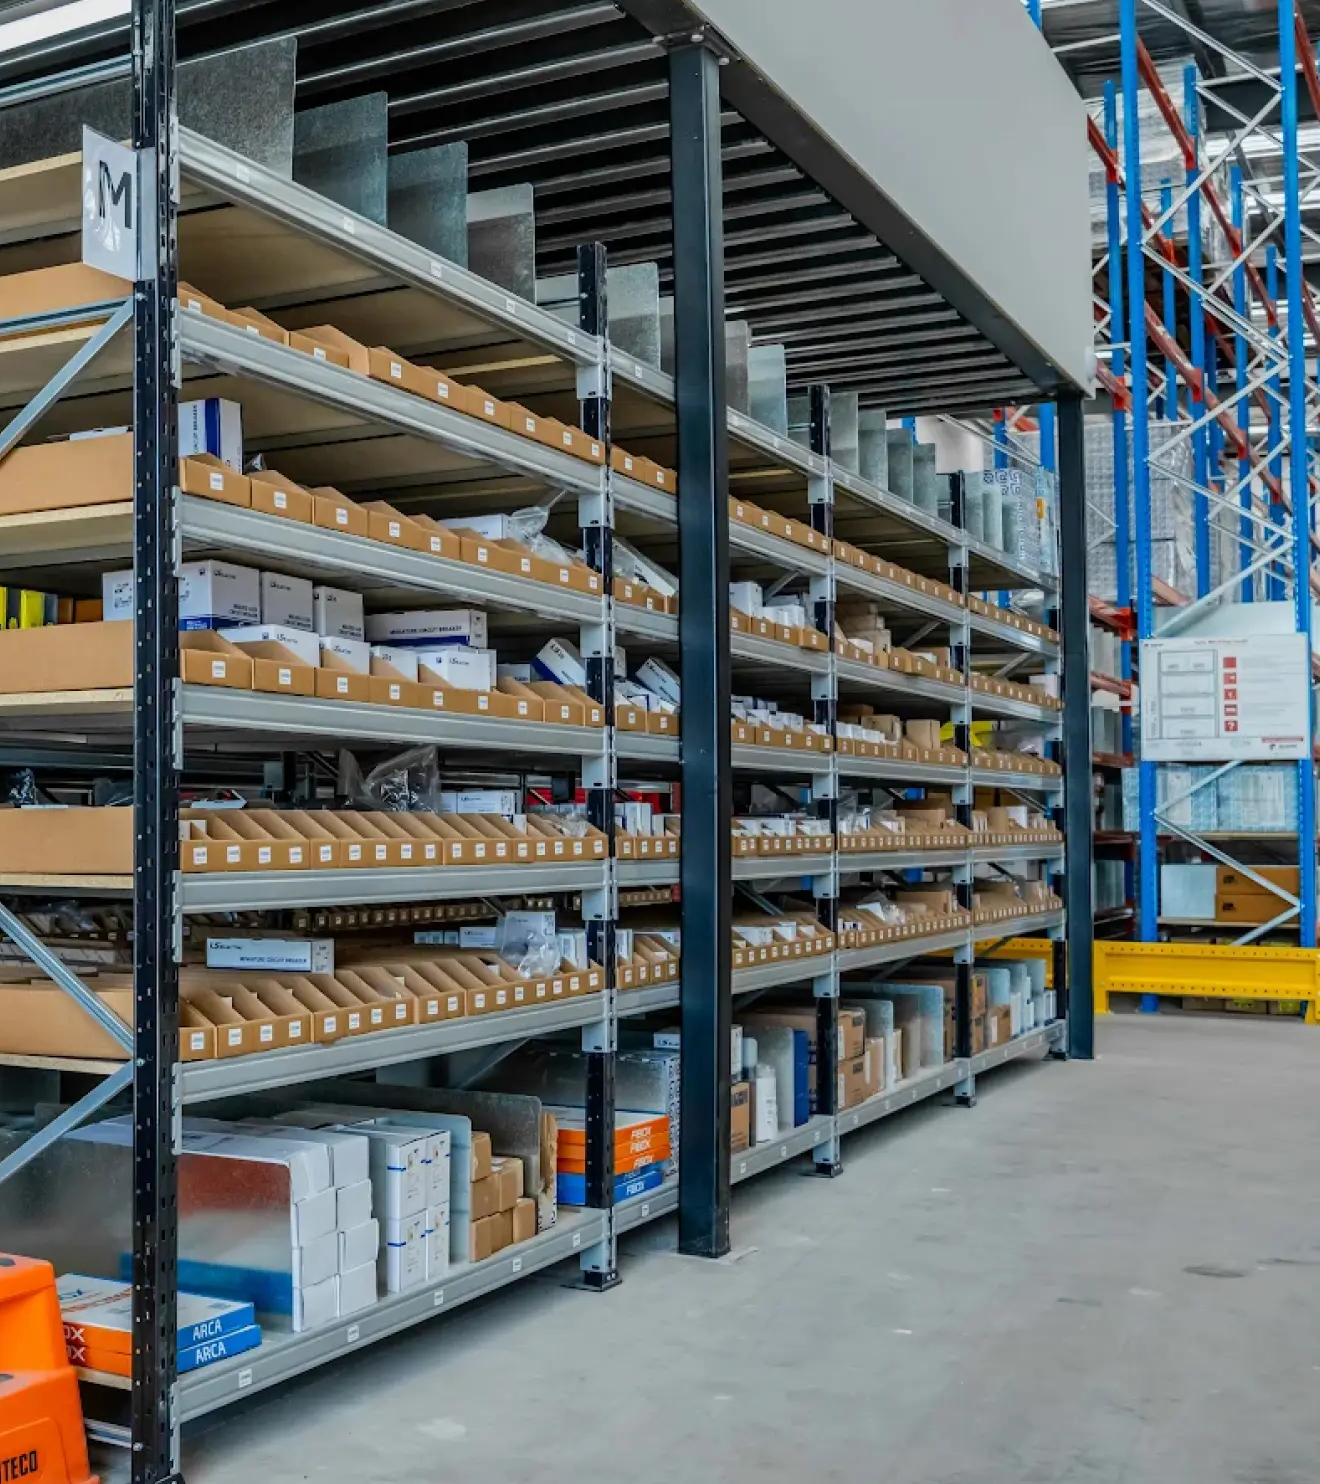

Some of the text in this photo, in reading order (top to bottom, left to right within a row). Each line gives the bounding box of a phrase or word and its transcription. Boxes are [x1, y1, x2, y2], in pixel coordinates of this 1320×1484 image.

[99, 160, 133, 230] M
[192, 1318, 223, 1341] ARCA
[195, 1342, 227, 1365] ARCA
